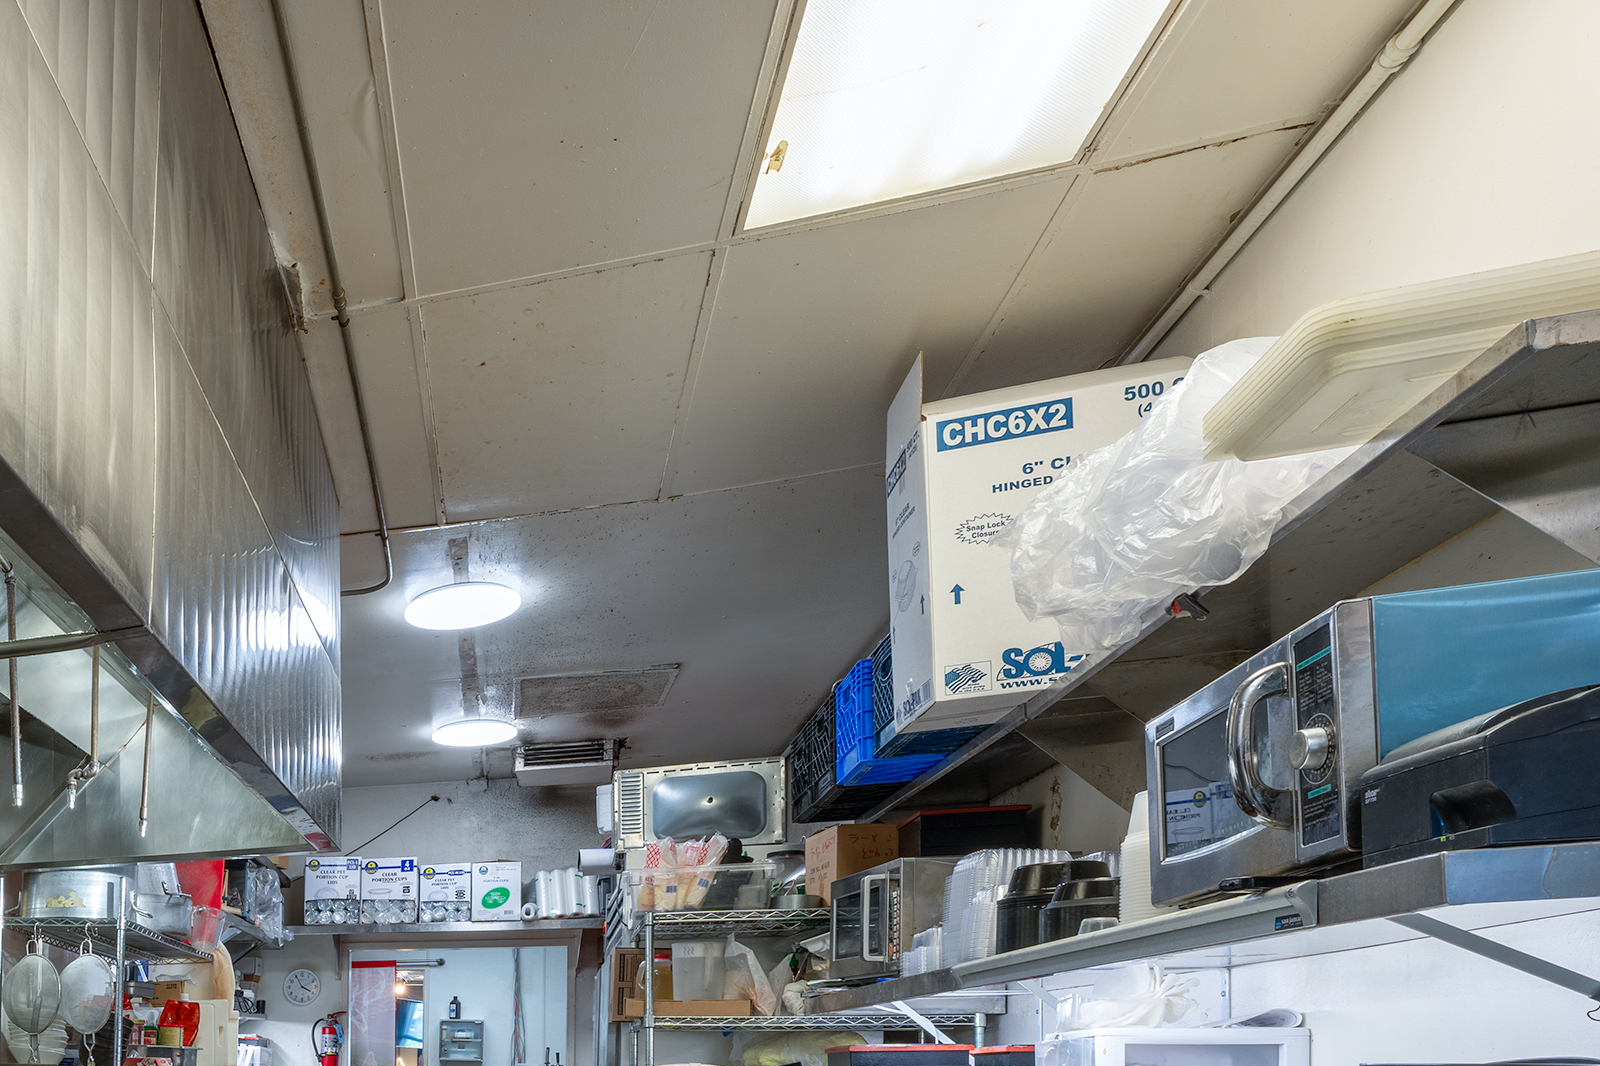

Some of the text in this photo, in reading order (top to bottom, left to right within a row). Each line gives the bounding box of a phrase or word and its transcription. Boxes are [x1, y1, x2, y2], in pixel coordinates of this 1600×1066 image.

[1123, 380, 1165, 402] 500
[941, 402, 1068, 447] CHC6X2
[1022, 460, 1044, 475] 6"
[991, 476, 1054, 494] HINGED
[966, 520, 1006, 533] Snap Lock
